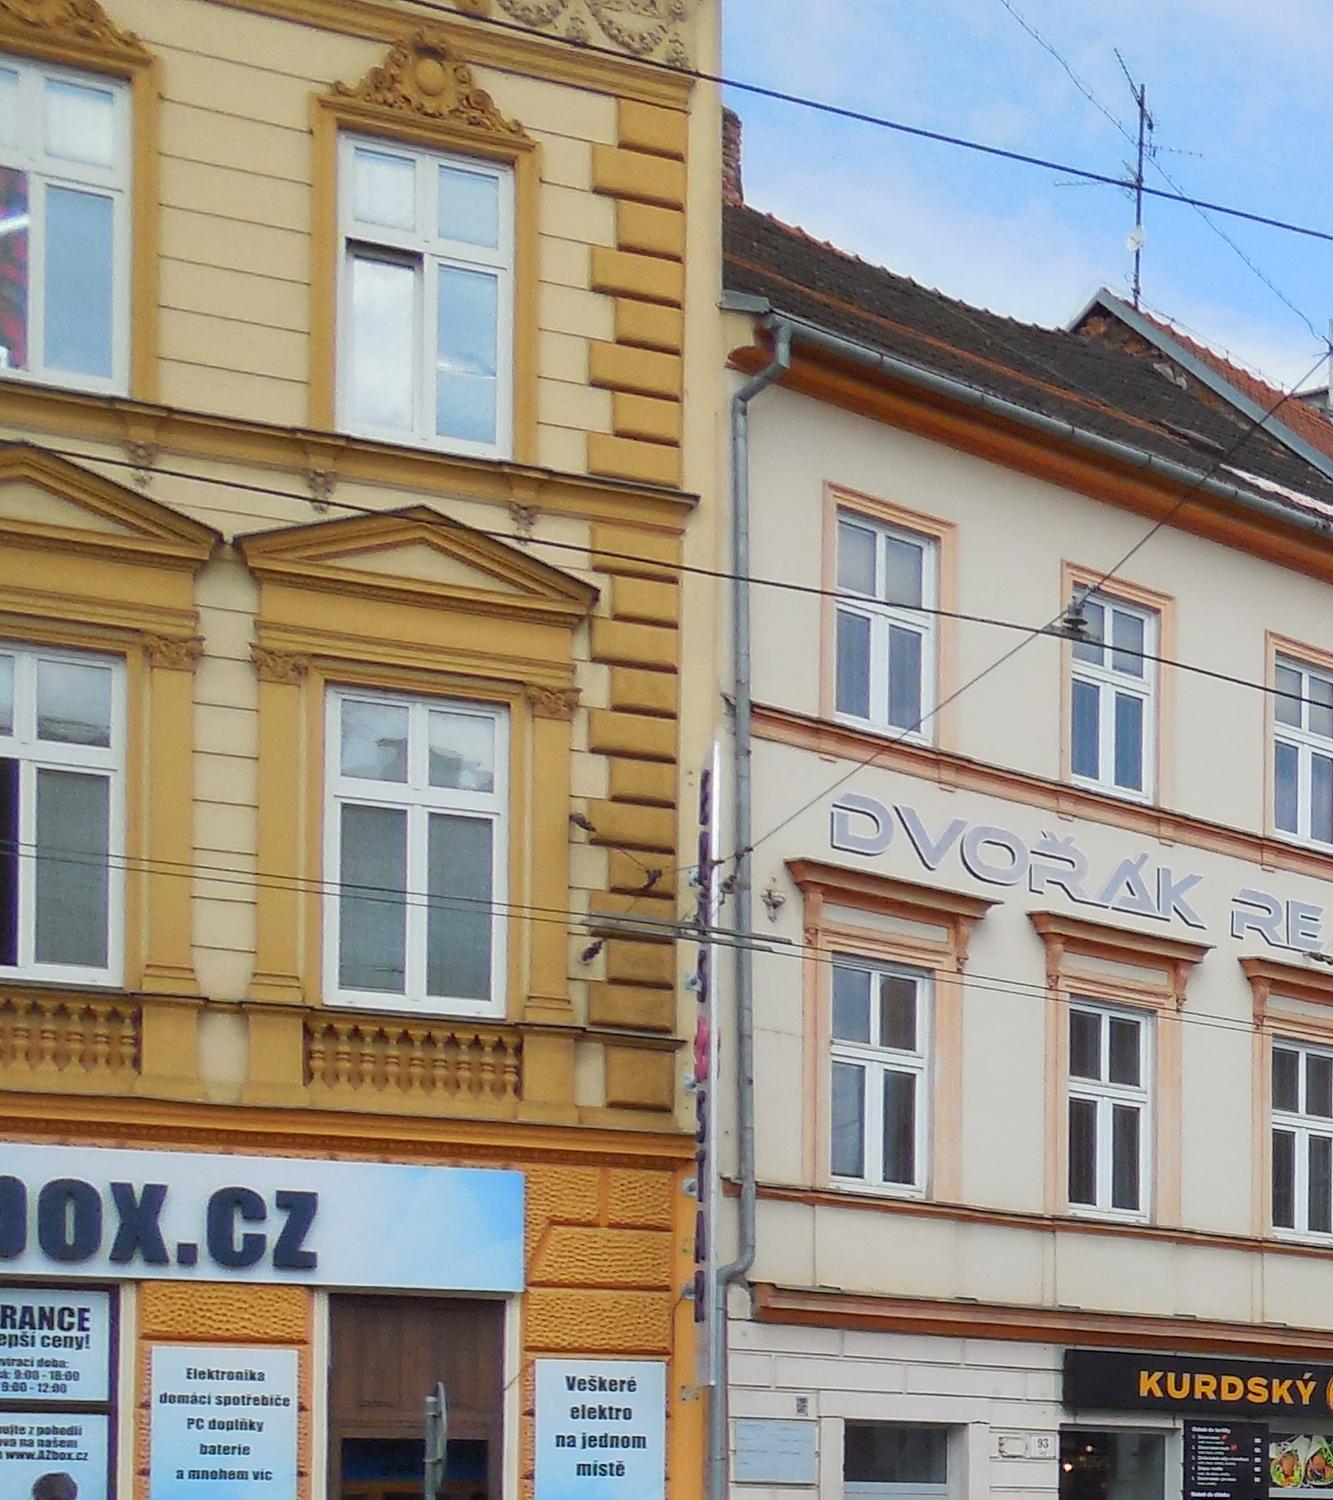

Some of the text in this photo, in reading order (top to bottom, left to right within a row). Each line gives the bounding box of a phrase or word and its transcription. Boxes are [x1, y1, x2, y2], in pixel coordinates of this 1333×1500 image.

[831, 792, 1207, 930] DVOŘÁK
[40, 1333, 91, 1350] ceny!
[37, 1358, 69, 1368] doba:
[14, 1369, 40, 1381] 9:00
[49, 1371, 80, 1382] 18:00
[186, 1367, 266, 1382] Elektronika
[37, 1383, 68, 1394] 12:00
[565, 1374, 638, 1394] Veškeré
[1138, 1371, 1317, 1406] KURDSKÝ
[159, 1391, 291, 1408] domácí spotřebiče
[570, 1404, 633, 1421] elektro
[28, 1425, 36, 1435] z
[187, 1417, 265, 1434] PC doplňky
[20, 1438, 35, 1448] na
[37, 1436, 78, 1449] našem
[555, 1431, 648, 1450] na jednom
[1037, 1437, 1050, 1450] 93
[5, 1450, 89, 1462] www.AZbox.cz
[199, 1442, 251, 1457] baterie
[176, 1469, 185, 1480] a
[188, 1467, 250, 1482] mnohem
[576, 1459, 626, 1477] místě
